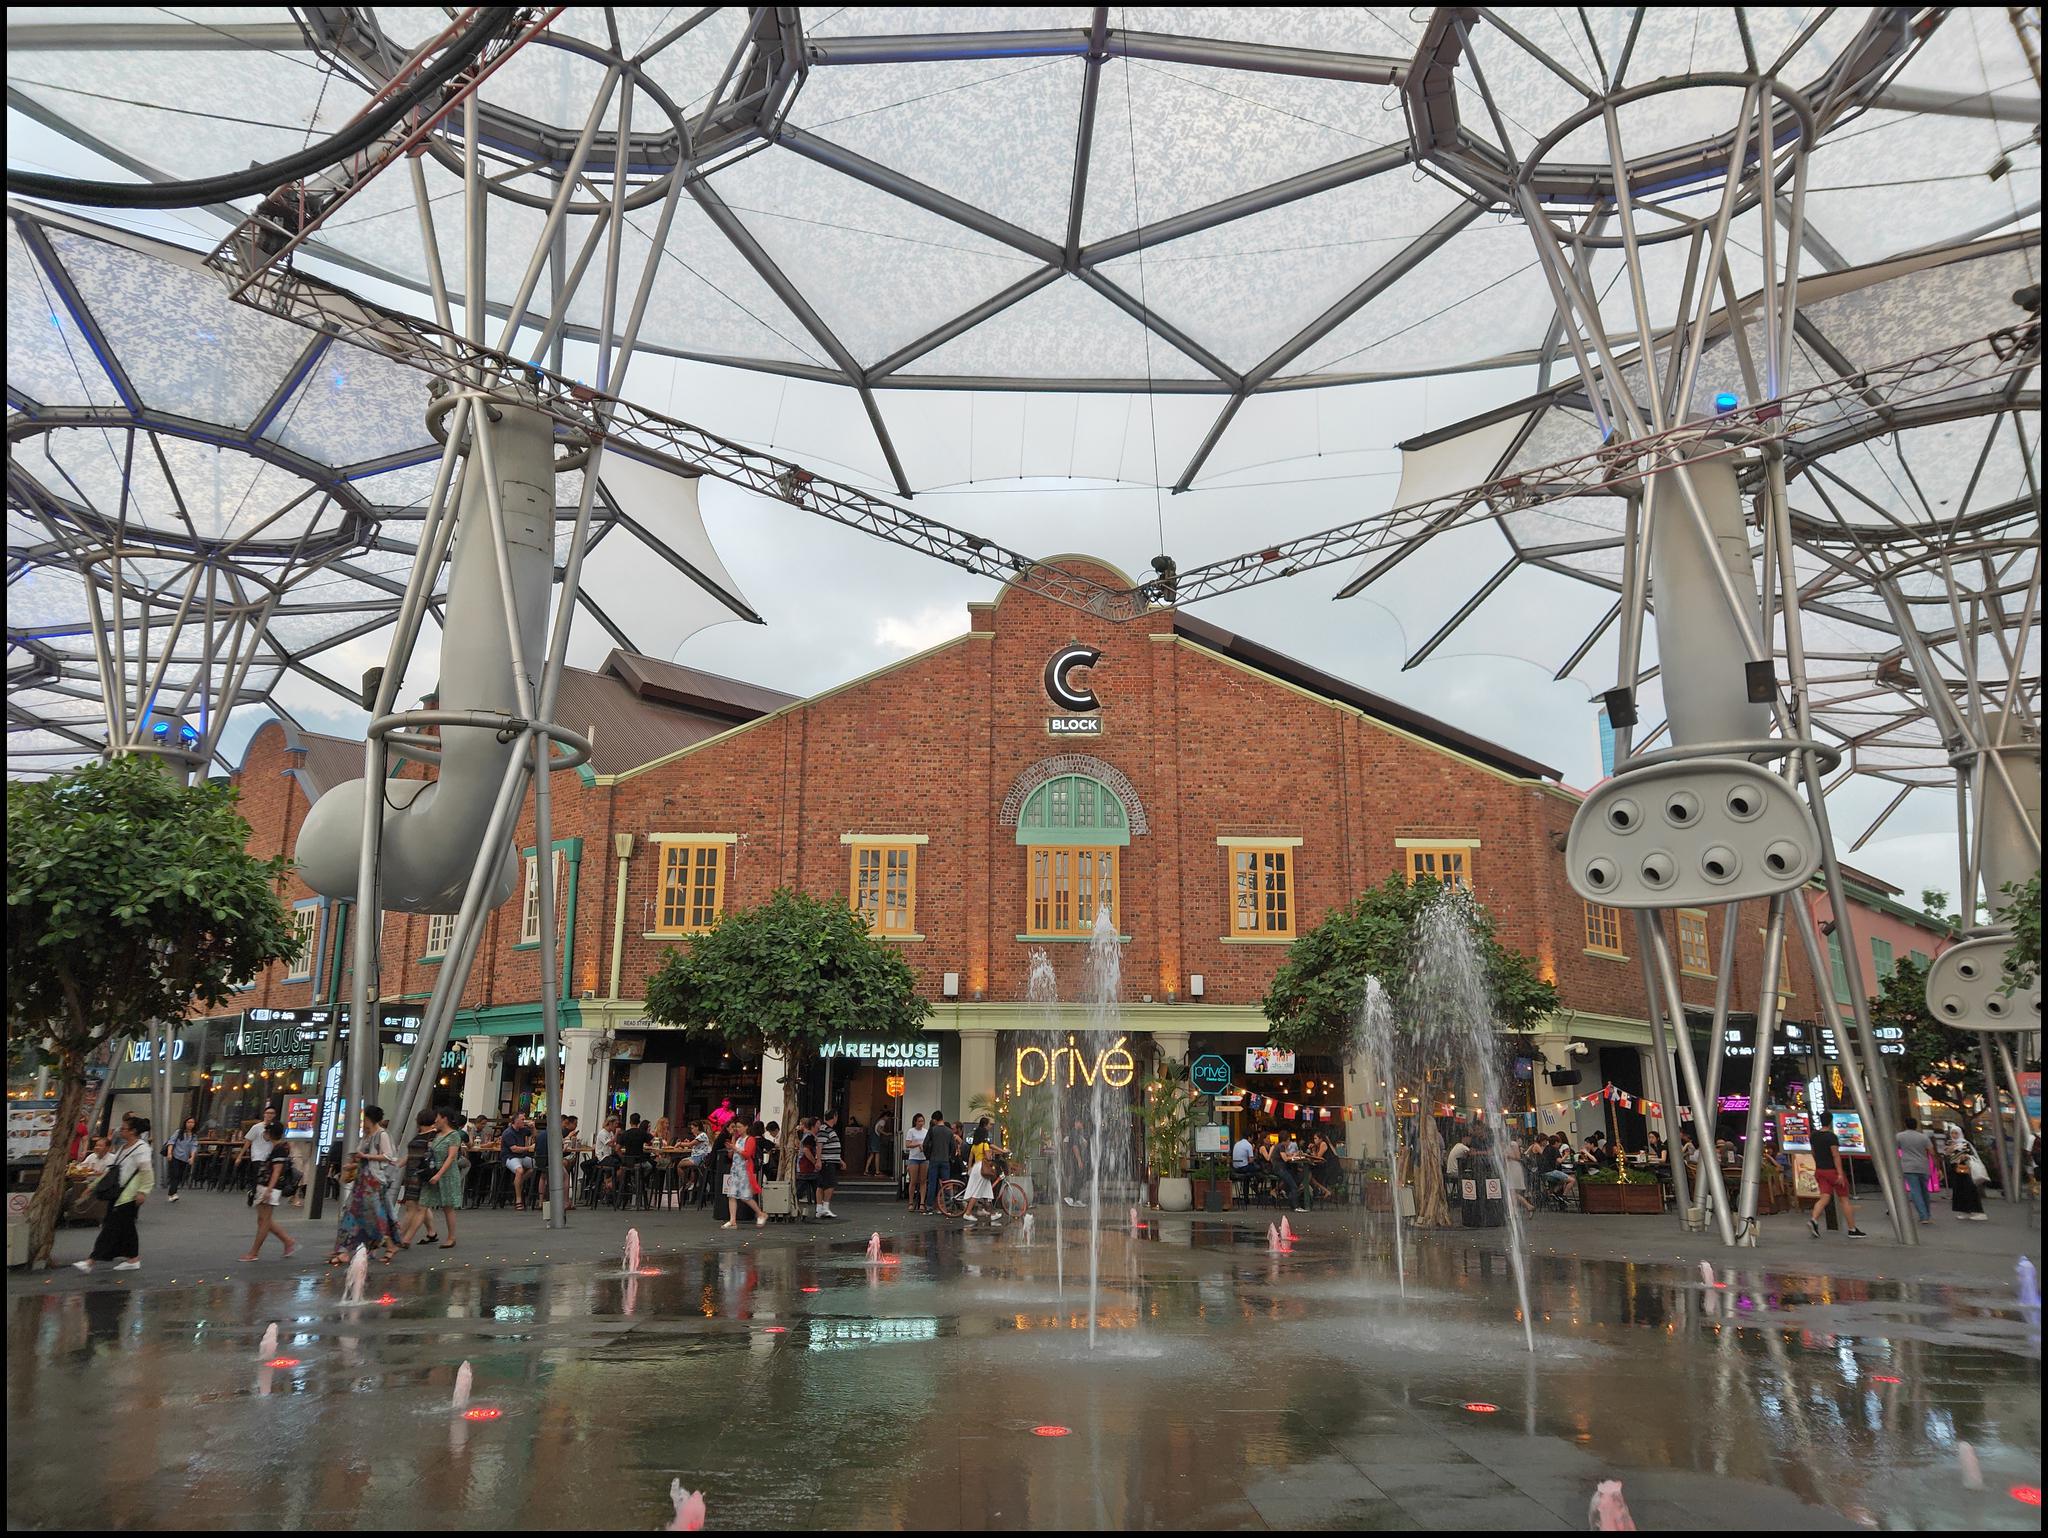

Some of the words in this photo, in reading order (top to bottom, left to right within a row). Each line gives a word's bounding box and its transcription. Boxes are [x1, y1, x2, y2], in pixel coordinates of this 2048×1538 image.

[1044, 645, 1101, 712] C
[1052, 719, 1097, 730] BLOCK
[819, 1036, 940, 1058] WAREHOUSE
[263, 1055, 310, 1070] SINGAPORE
[877, 1058, 940, 1068] SINGAPORE
[1016, 1035, 1134, 1096] privé
[1194, 1063, 1228, 1080] privé
